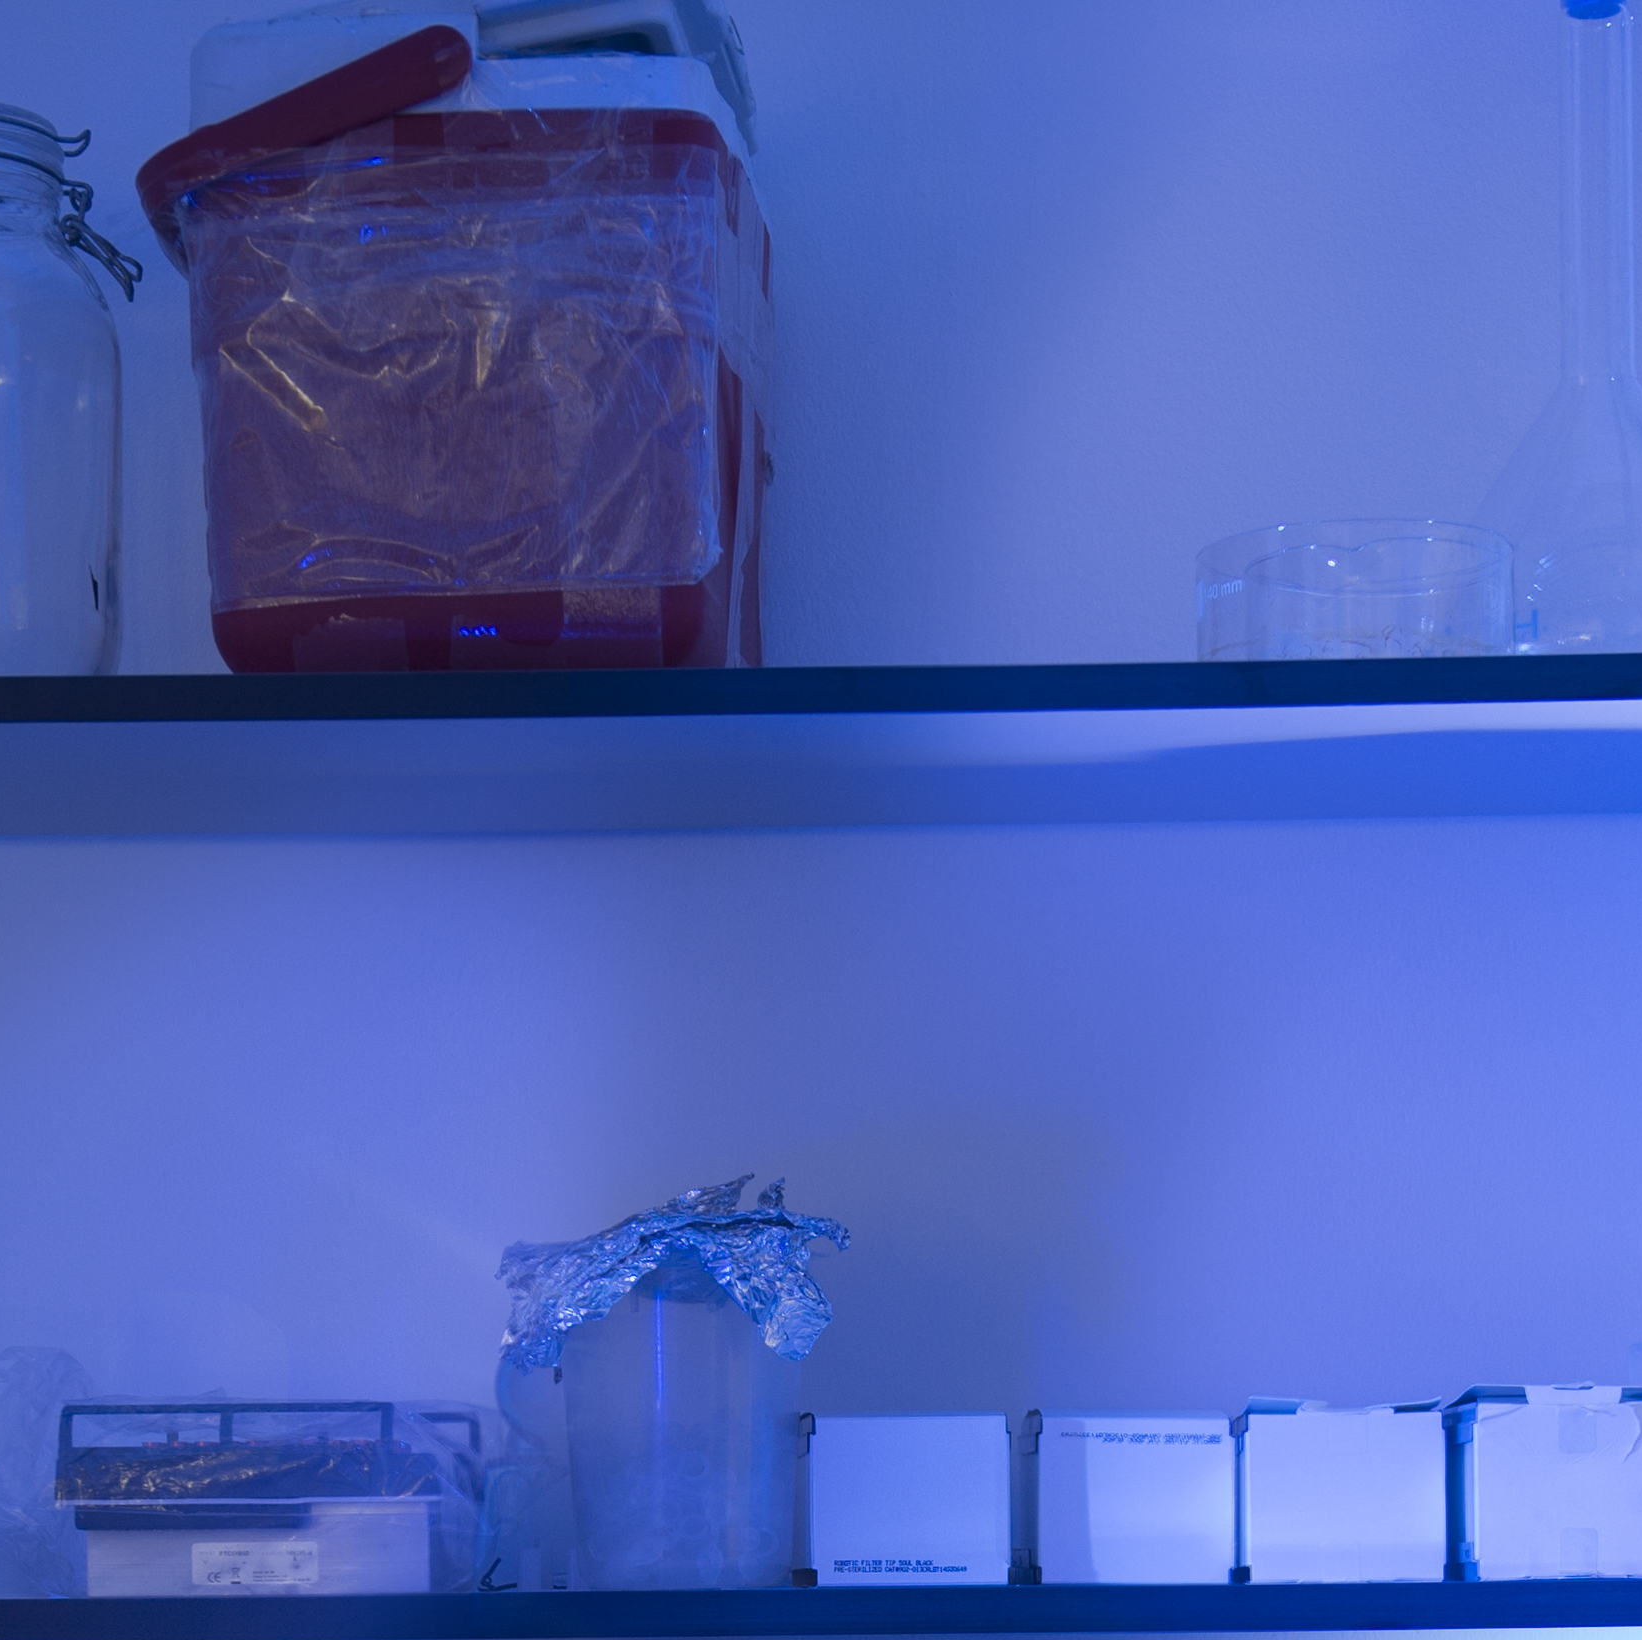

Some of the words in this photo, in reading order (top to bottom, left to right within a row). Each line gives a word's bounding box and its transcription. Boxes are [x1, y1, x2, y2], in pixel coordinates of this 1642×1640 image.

[833, 1559, 858, 1567] ROBOTIC
[861, 1559, 883, 1567] FILTER
[885, 1559, 897, 1567] TIP
[915, 1559, 934, 1567] BLACK
